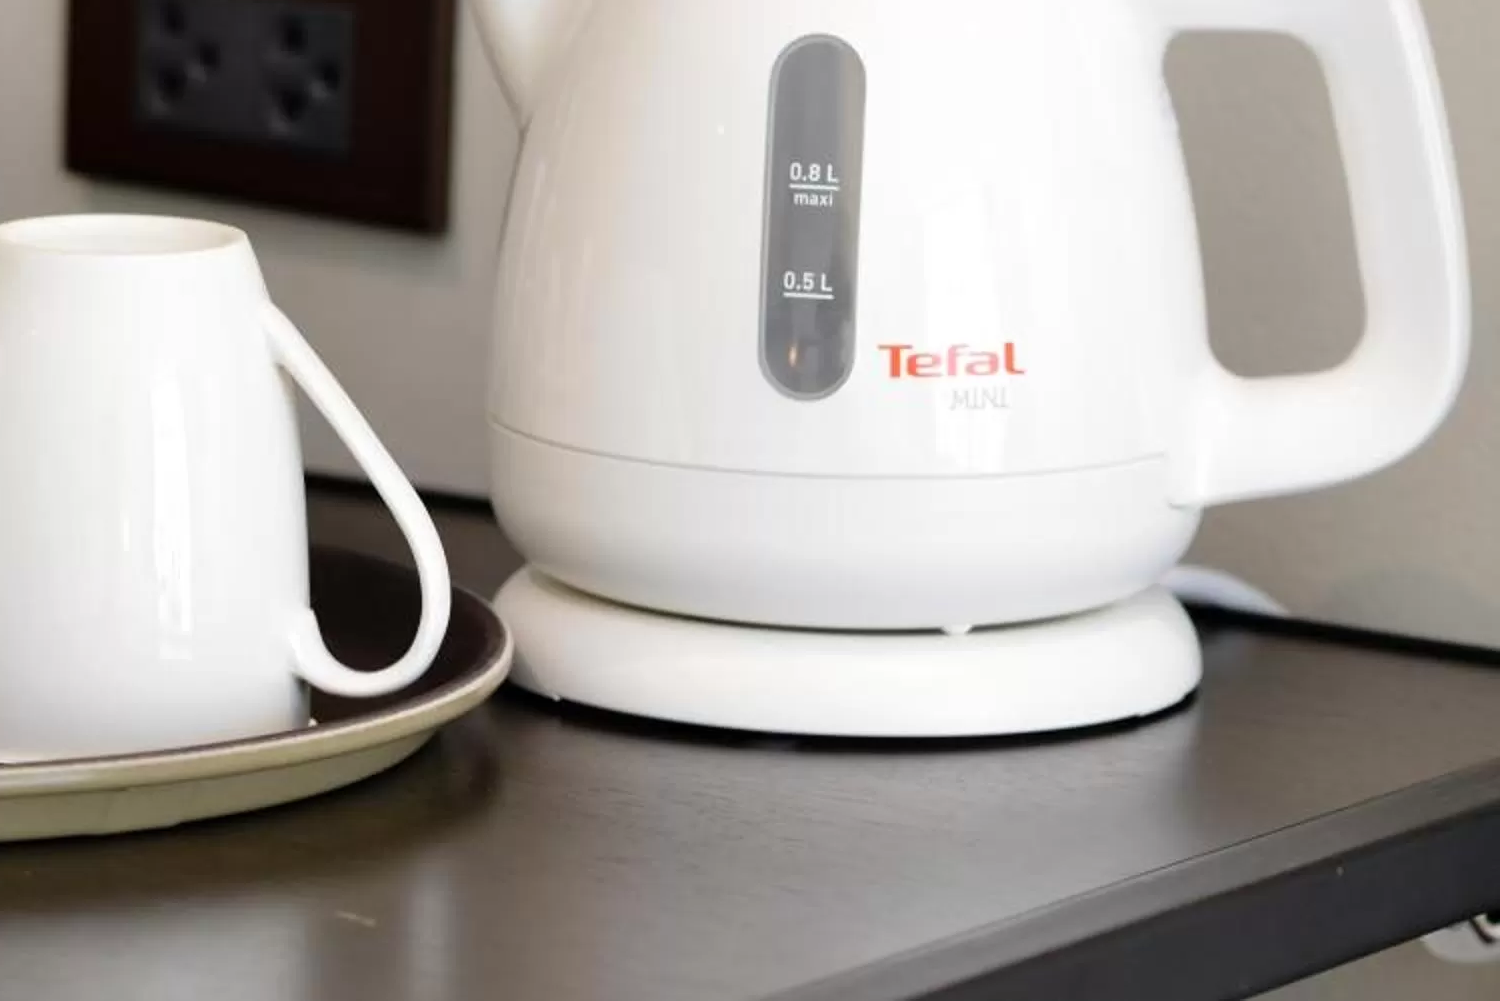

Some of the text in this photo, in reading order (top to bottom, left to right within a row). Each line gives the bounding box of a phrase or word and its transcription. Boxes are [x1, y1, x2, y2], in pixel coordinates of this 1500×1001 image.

[789, 161, 840, 184] 0.8 L
[793, 190, 833, 207] maxi
[782, 269, 834, 293] 0.5 L
[877, 341, 1026, 379] Tefal
[948, 385, 1010, 411] MINI
